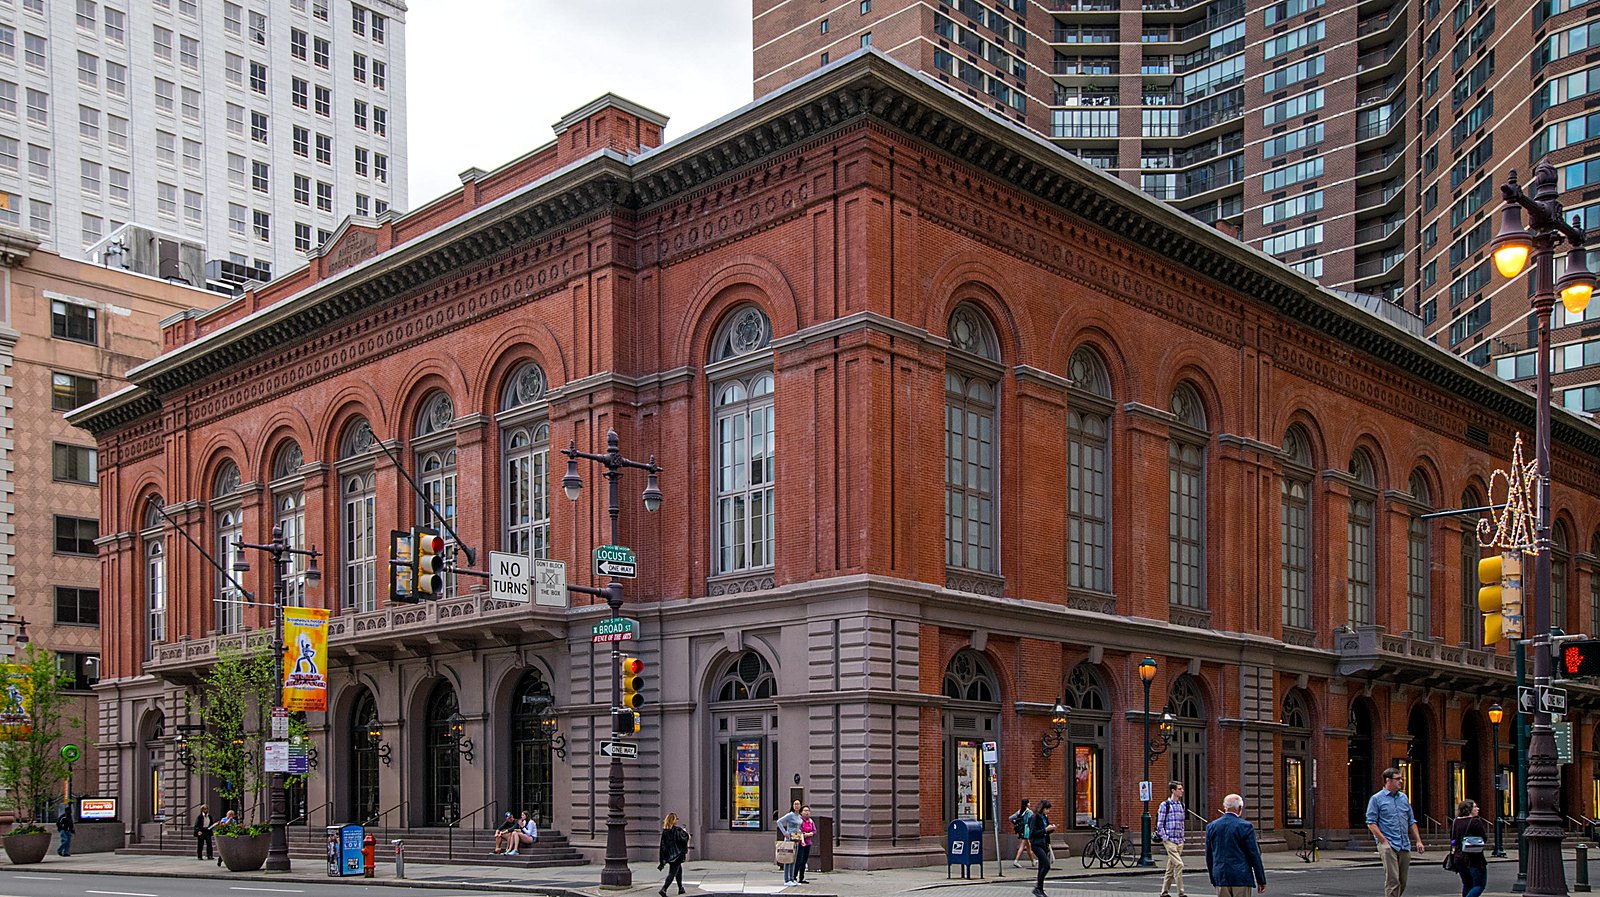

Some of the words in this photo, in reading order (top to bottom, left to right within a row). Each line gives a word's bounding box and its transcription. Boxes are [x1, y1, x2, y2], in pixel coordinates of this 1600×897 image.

[597, 550, 627, 561] LOCUST
[500, 561, 521, 577] NO
[493, 580, 528, 595] TURNS
[599, 623, 624, 634] BROAD
[1548, 695, 1556, 706] ONE
[1556, 697, 1564, 707] WAY
